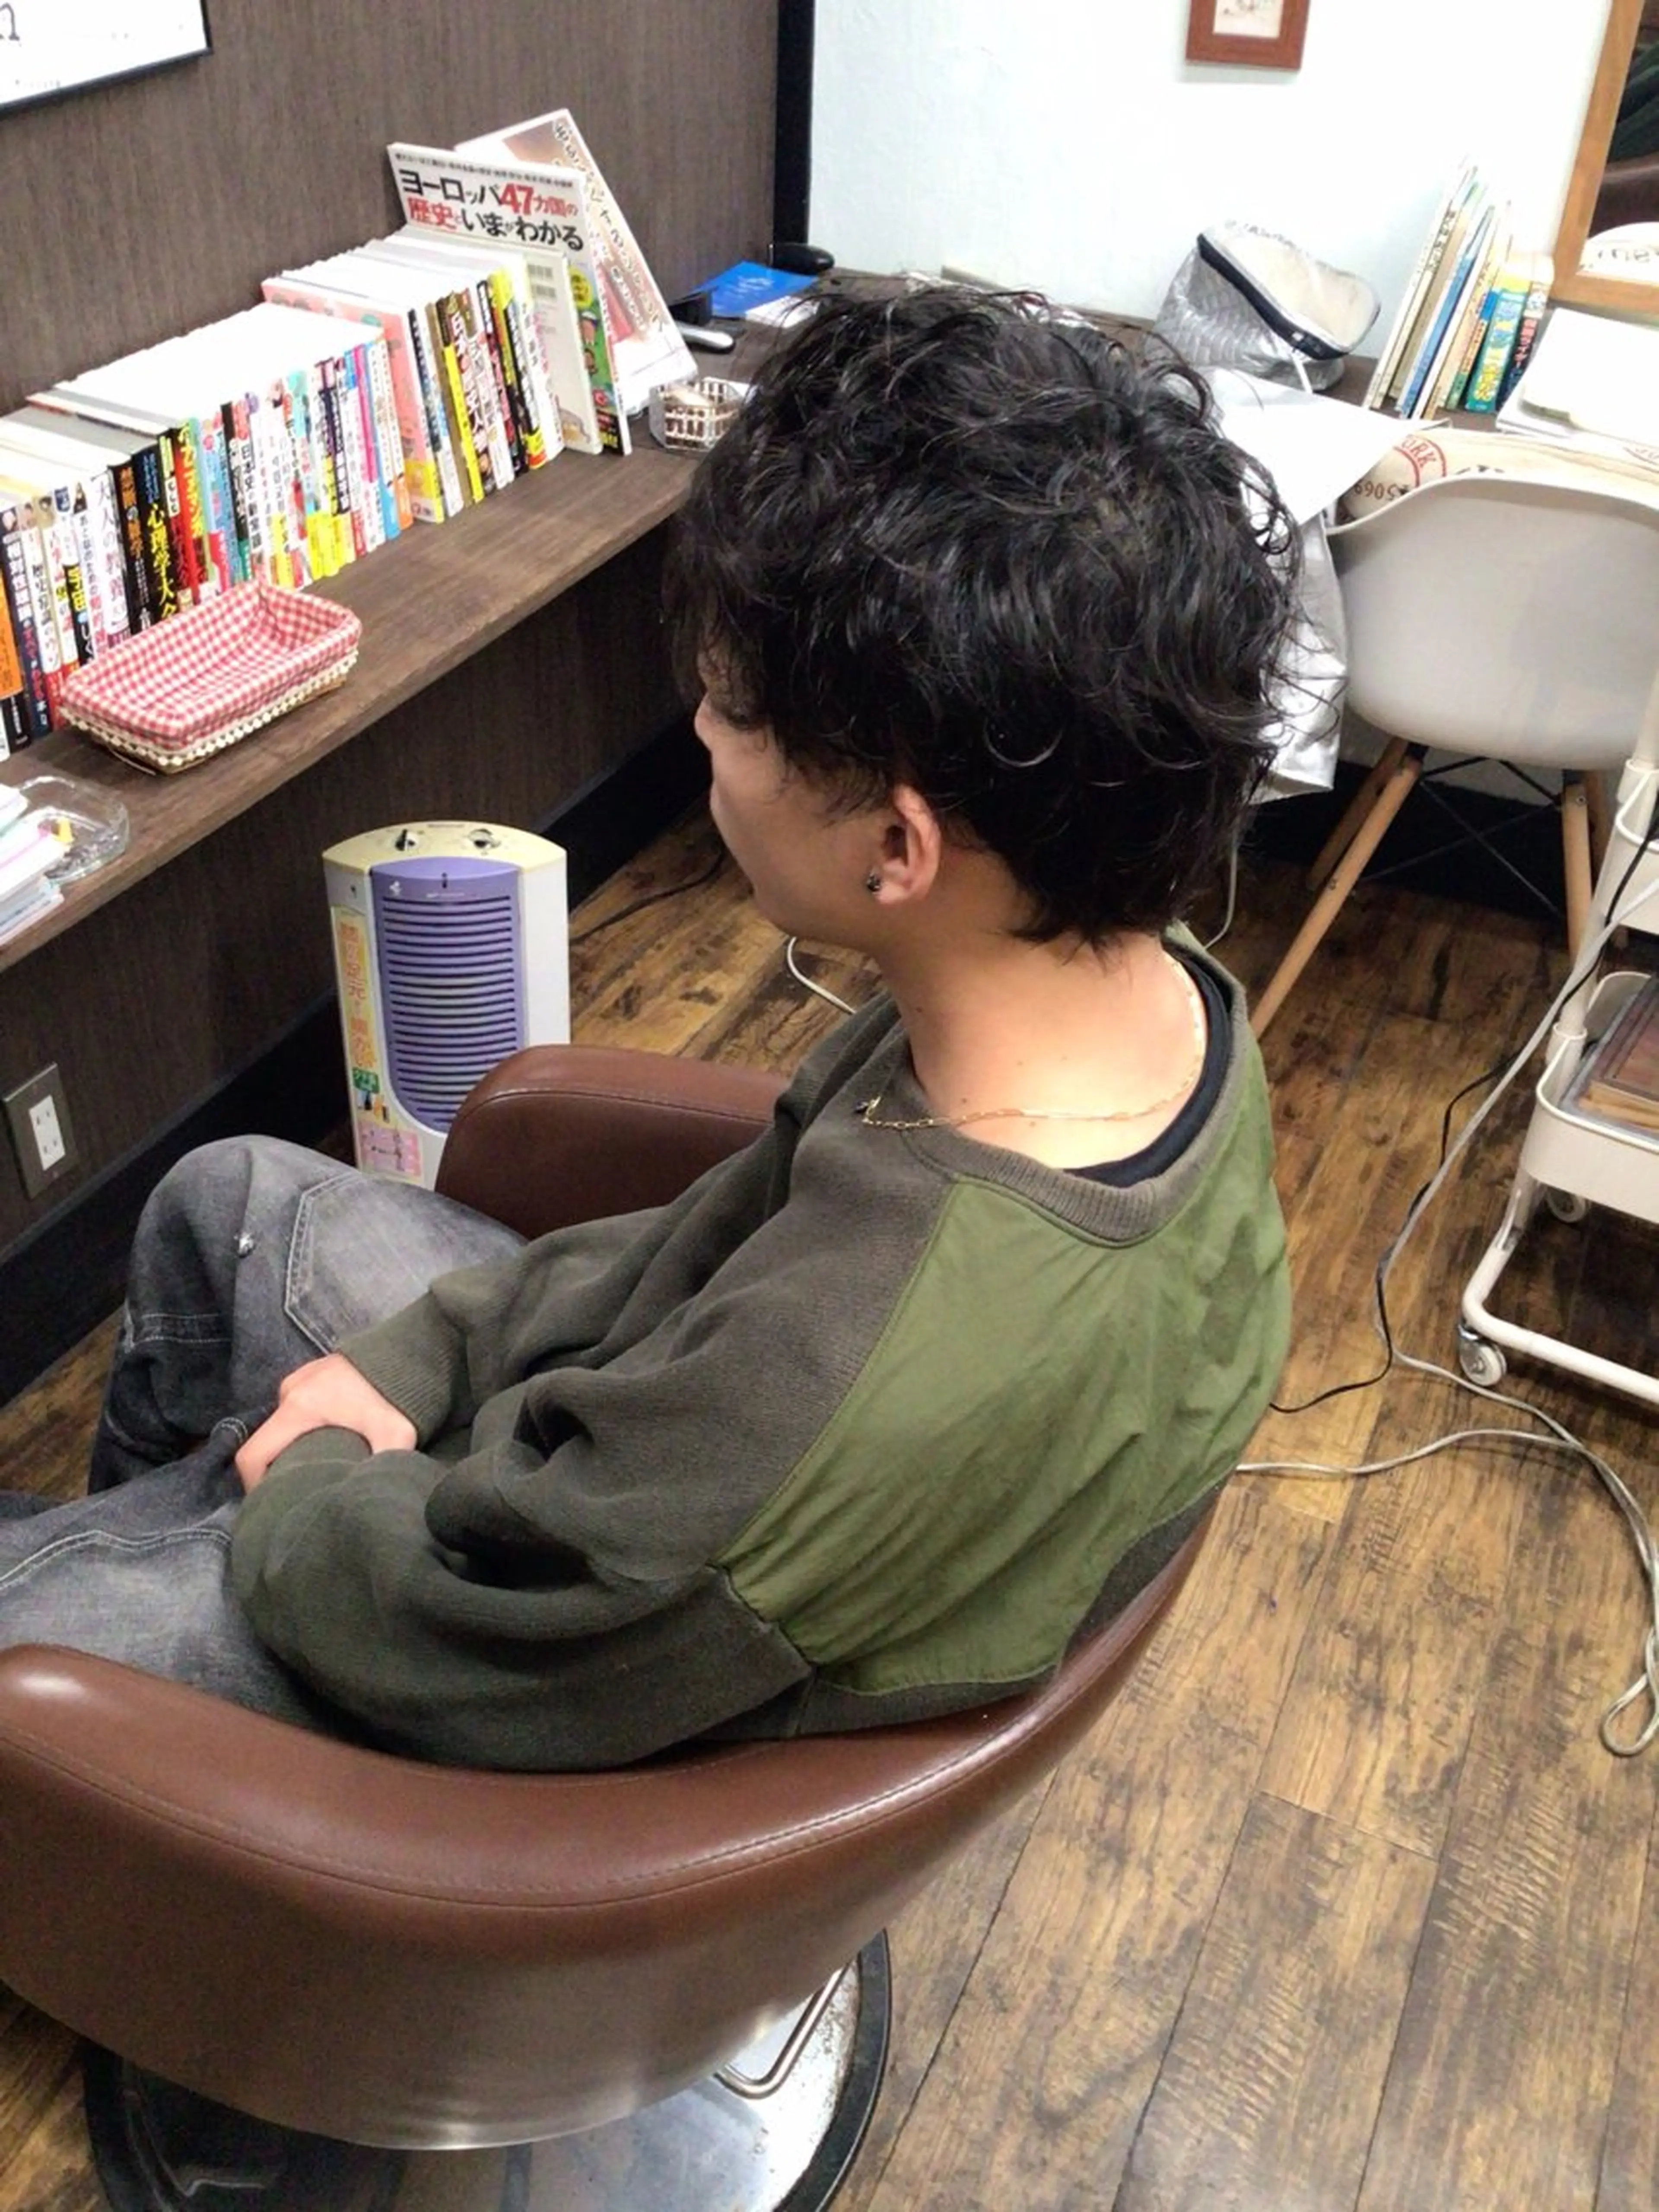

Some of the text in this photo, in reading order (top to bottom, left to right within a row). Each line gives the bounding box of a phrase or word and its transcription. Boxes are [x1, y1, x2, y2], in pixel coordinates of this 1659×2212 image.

[408, 197, 584, 252] 歴史といまがわかる
